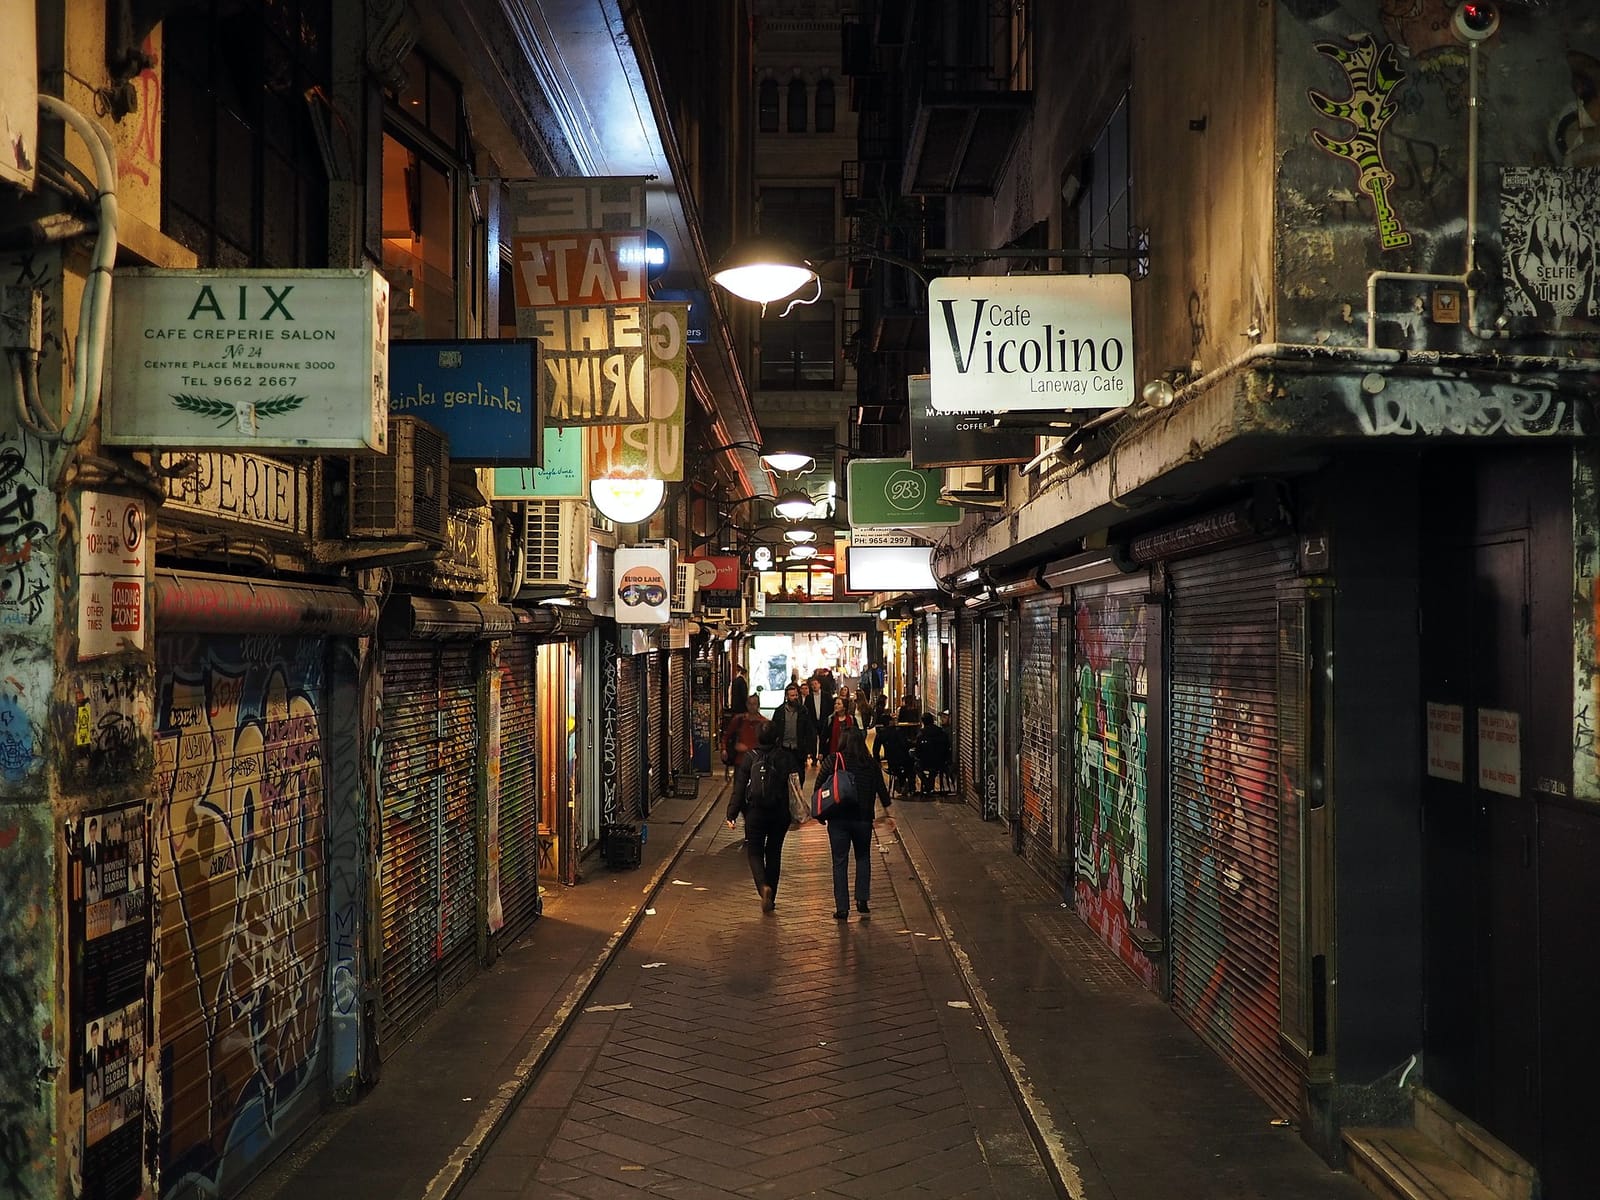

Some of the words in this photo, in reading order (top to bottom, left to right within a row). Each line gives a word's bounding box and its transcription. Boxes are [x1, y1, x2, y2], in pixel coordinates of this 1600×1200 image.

[1537, 266, 1576, 279] SELFIE
[1538, 283, 1576, 301] THIS
[187, 285, 295, 321] AIX
[989, 304, 1031, 327] Cafe
[144, 329, 187, 340] CAFE
[193, 329, 274, 340] CREPERIE
[281, 329, 336, 340] SALON
[937, 299, 1123, 374] Vicolino
[248, 346, 262, 358] 24
[144, 360, 188, 369] CENTRE
[193, 360, 228, 369] PLACE
[232, 360, 301, 369] MELBOURNE
[305, 360, 335, 369] 3000
[181, 376, 208, 386] TEL
[213, 376, 252, 386] 9662
[259, 376, 297, 387] 2667
[1030, 376, 1088, 395] Laneway
[1093, 375, 1124, 392] Cafe
[443, 381, 522, 414] gerlinki
[91, 592, 100, 603] ALL
[112, 588, 140, 605] LOADING
[86, 606, 104, 617] OTHER
[113, 608, 138, 625] ZONE
[87, 619, 103, 630] TIMES
[104, 858, 127, 872] MONTHLY
[104, 869, 127, 883] GLOBAL
[104, 1055, 127, 1073] MONTHLY
[104, 1066, 128, 1084] GLOBAL
